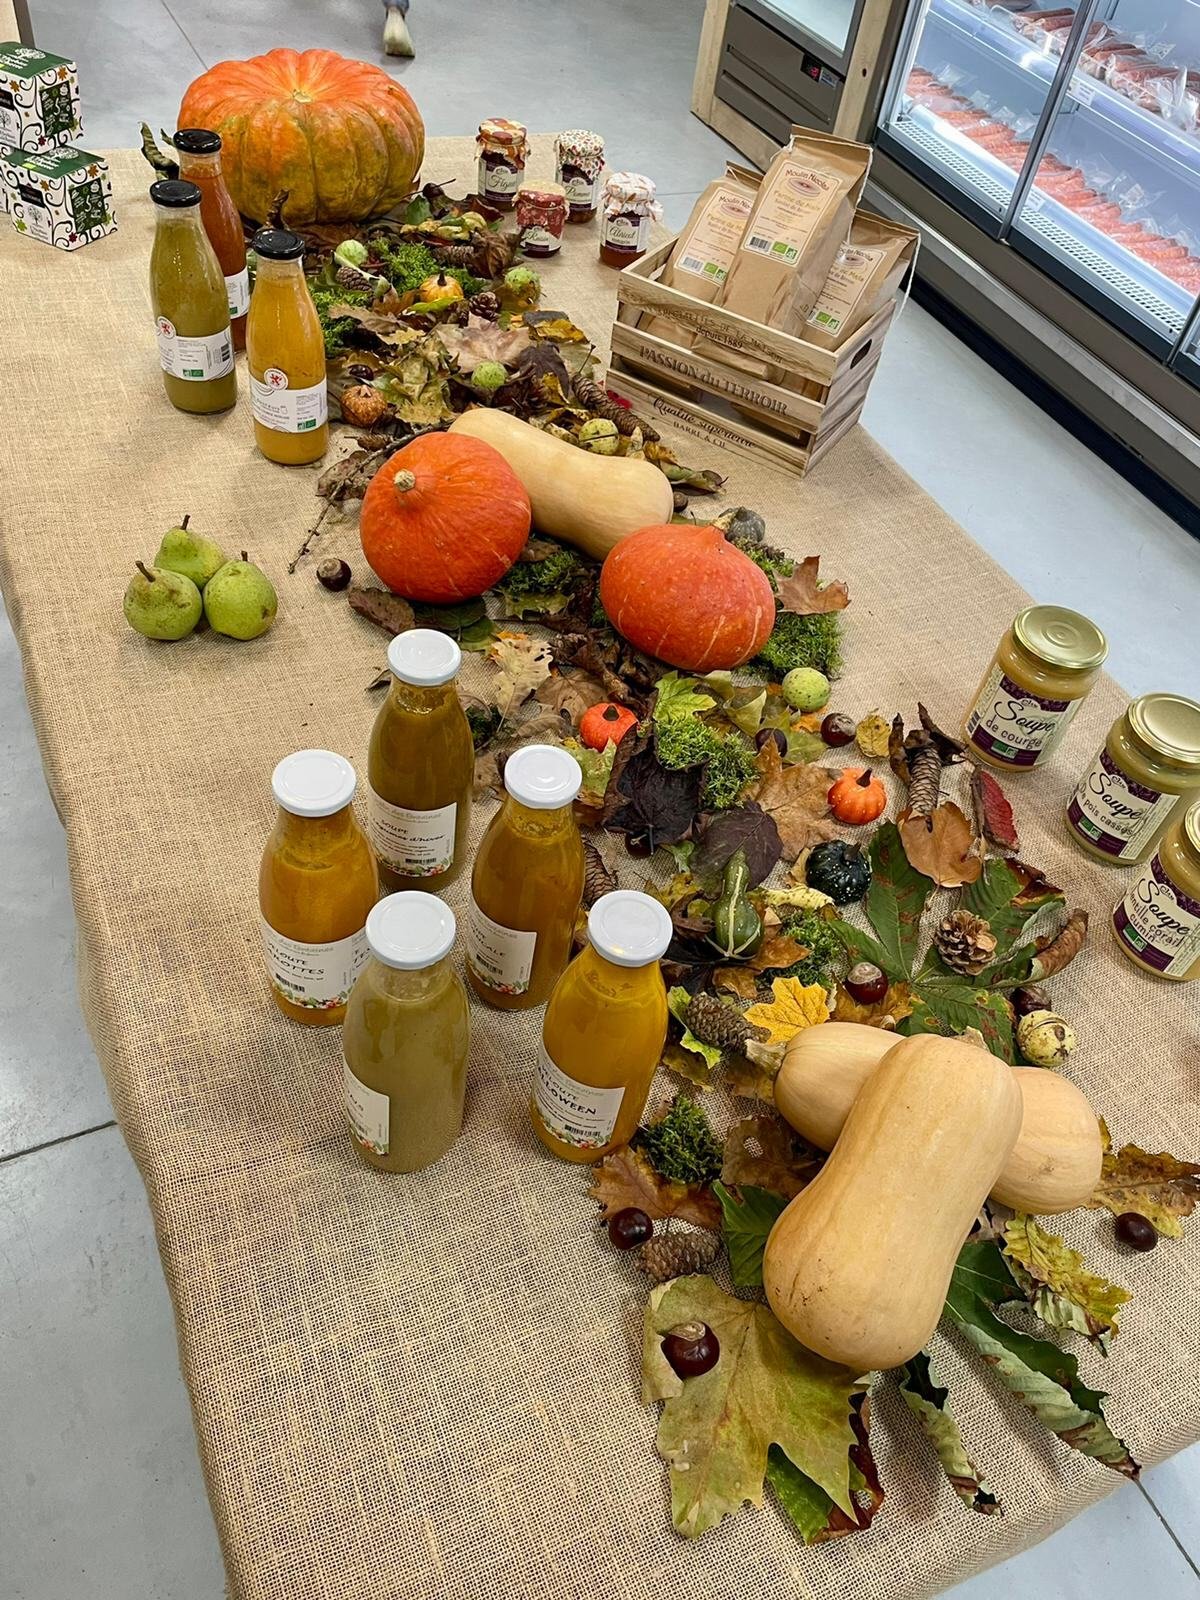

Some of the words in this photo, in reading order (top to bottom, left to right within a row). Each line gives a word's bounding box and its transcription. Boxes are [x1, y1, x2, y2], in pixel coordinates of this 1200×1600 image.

[723, 333, 743, 349] 1889
[640, 345, 699, 380] PASSION
[700, 371, 720, 388] du
[720, 378, 789, 416] TERROIR
[985, 714, 999, 733] de
[1000, 729, 1043, 751] courge
[994, 700, 1057, 735] Soupe
[1083, 798, 1101, 817] pois
[1088, 771, 1142, 820] Soupe
[1137, 877, 1191, 936] Soupe
[1129, 913, 1156, 944] cumin
[1149, 924, 1186, 949] corail
